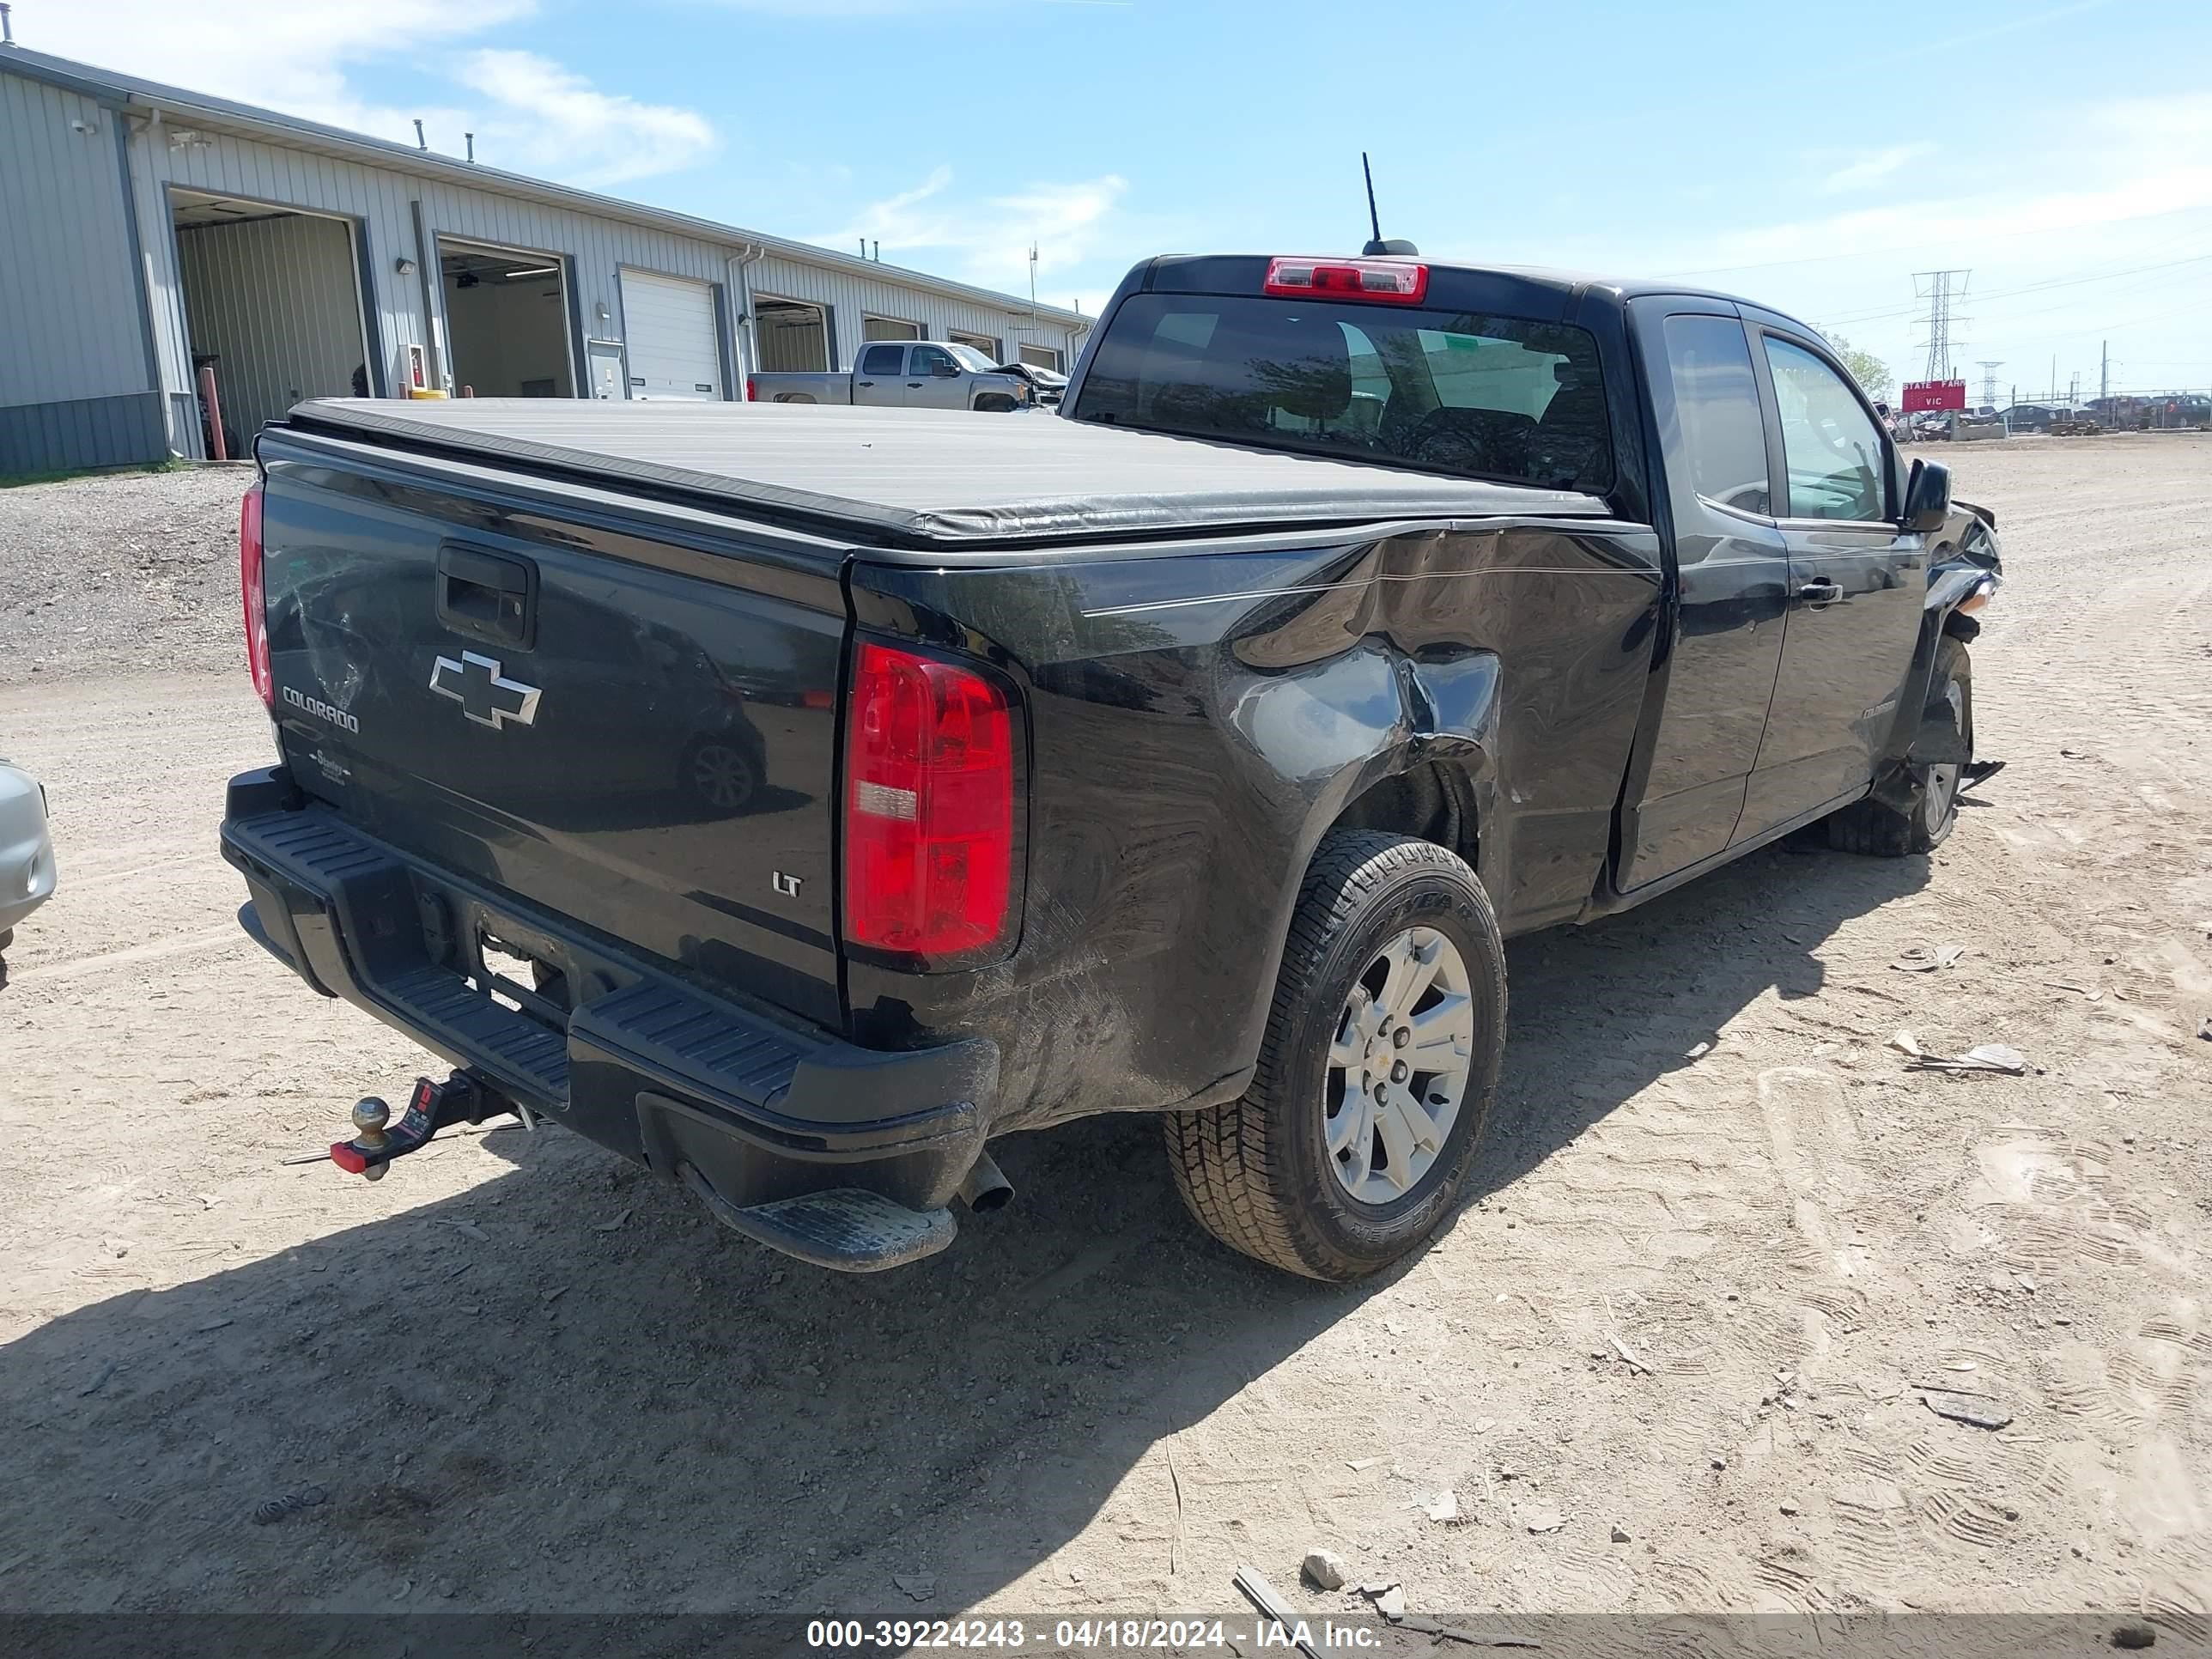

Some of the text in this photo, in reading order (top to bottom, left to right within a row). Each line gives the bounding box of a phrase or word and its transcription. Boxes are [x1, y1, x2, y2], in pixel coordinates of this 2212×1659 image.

[1903, 380, 1966, 391] STATE FARM
[283, 686, 359, 734] COLORADO
[773, 871, 801, 897] LT
